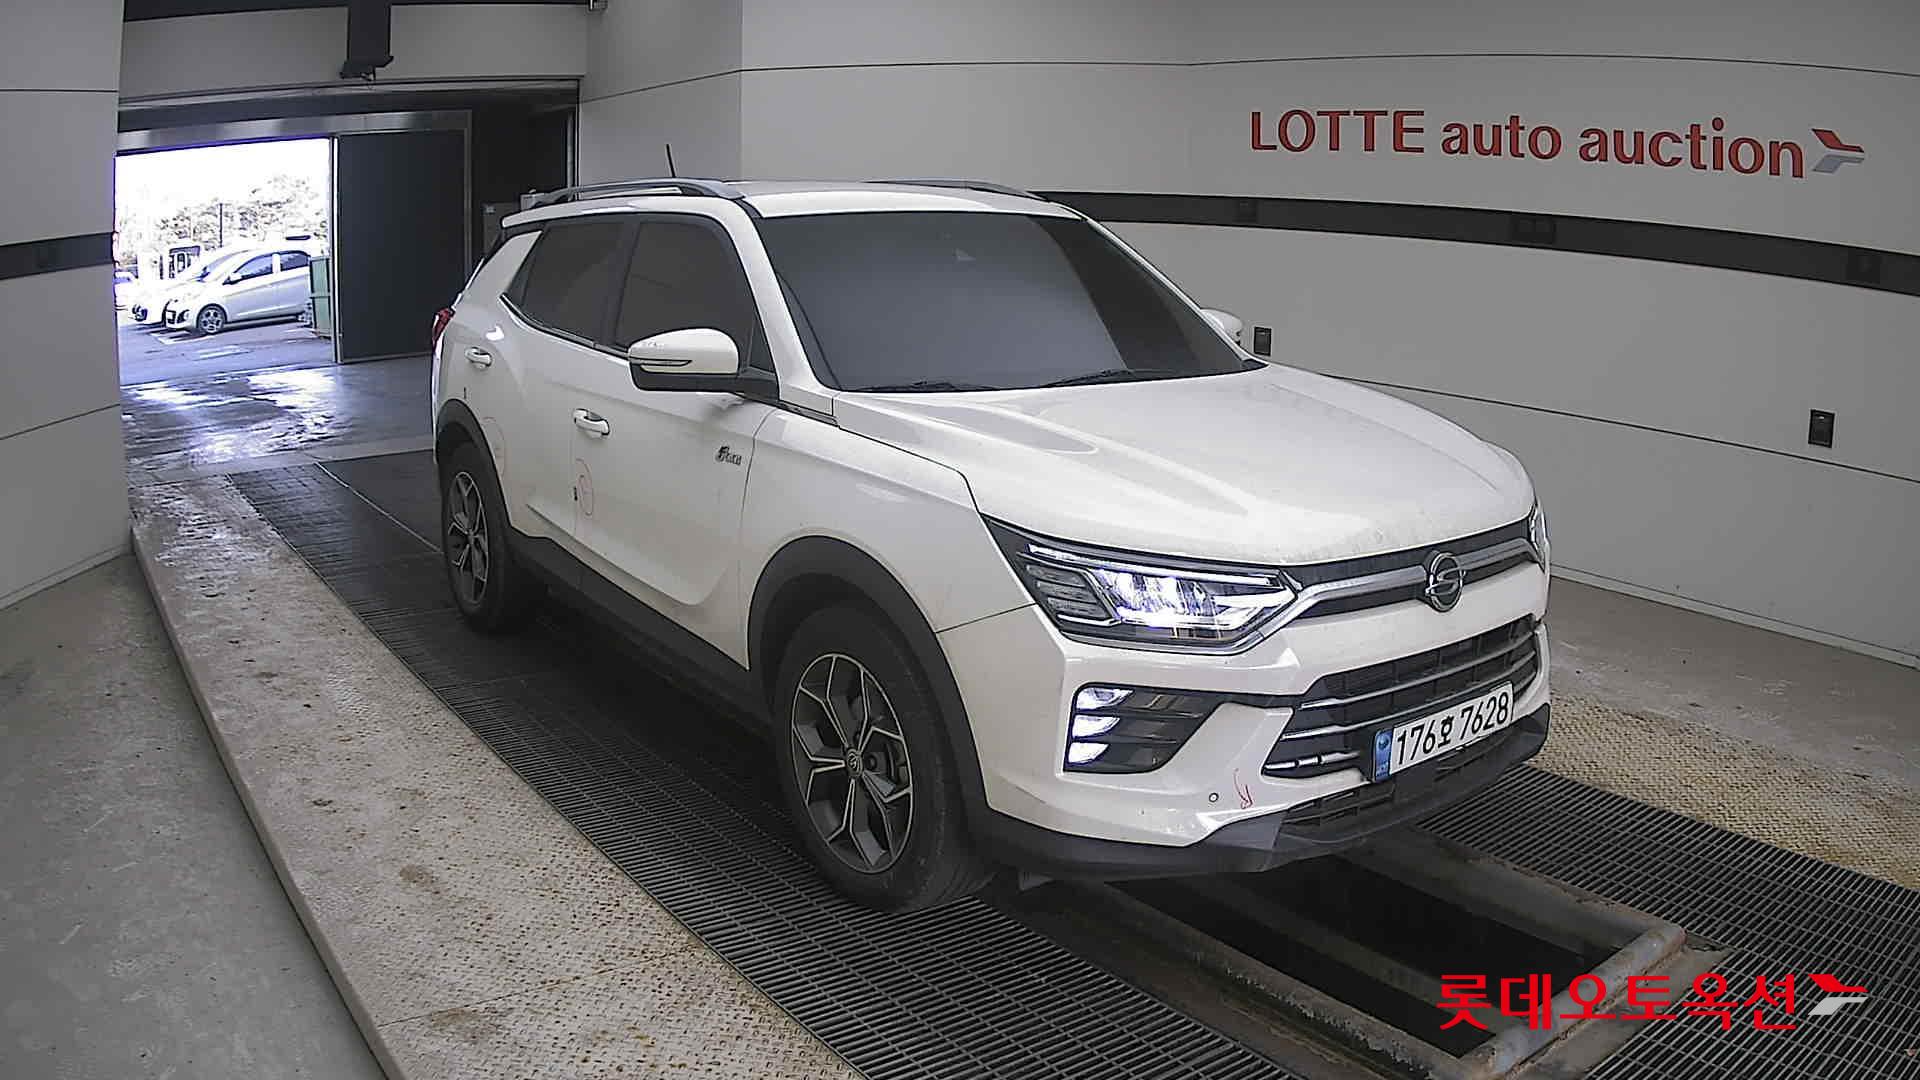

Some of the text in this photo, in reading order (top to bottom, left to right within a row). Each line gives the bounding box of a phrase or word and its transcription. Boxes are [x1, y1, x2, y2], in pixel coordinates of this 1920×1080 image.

[1250, 109, 1804, 178] LOTTE auto auction
[1397, 692, 1509, 765] 176호 7628
